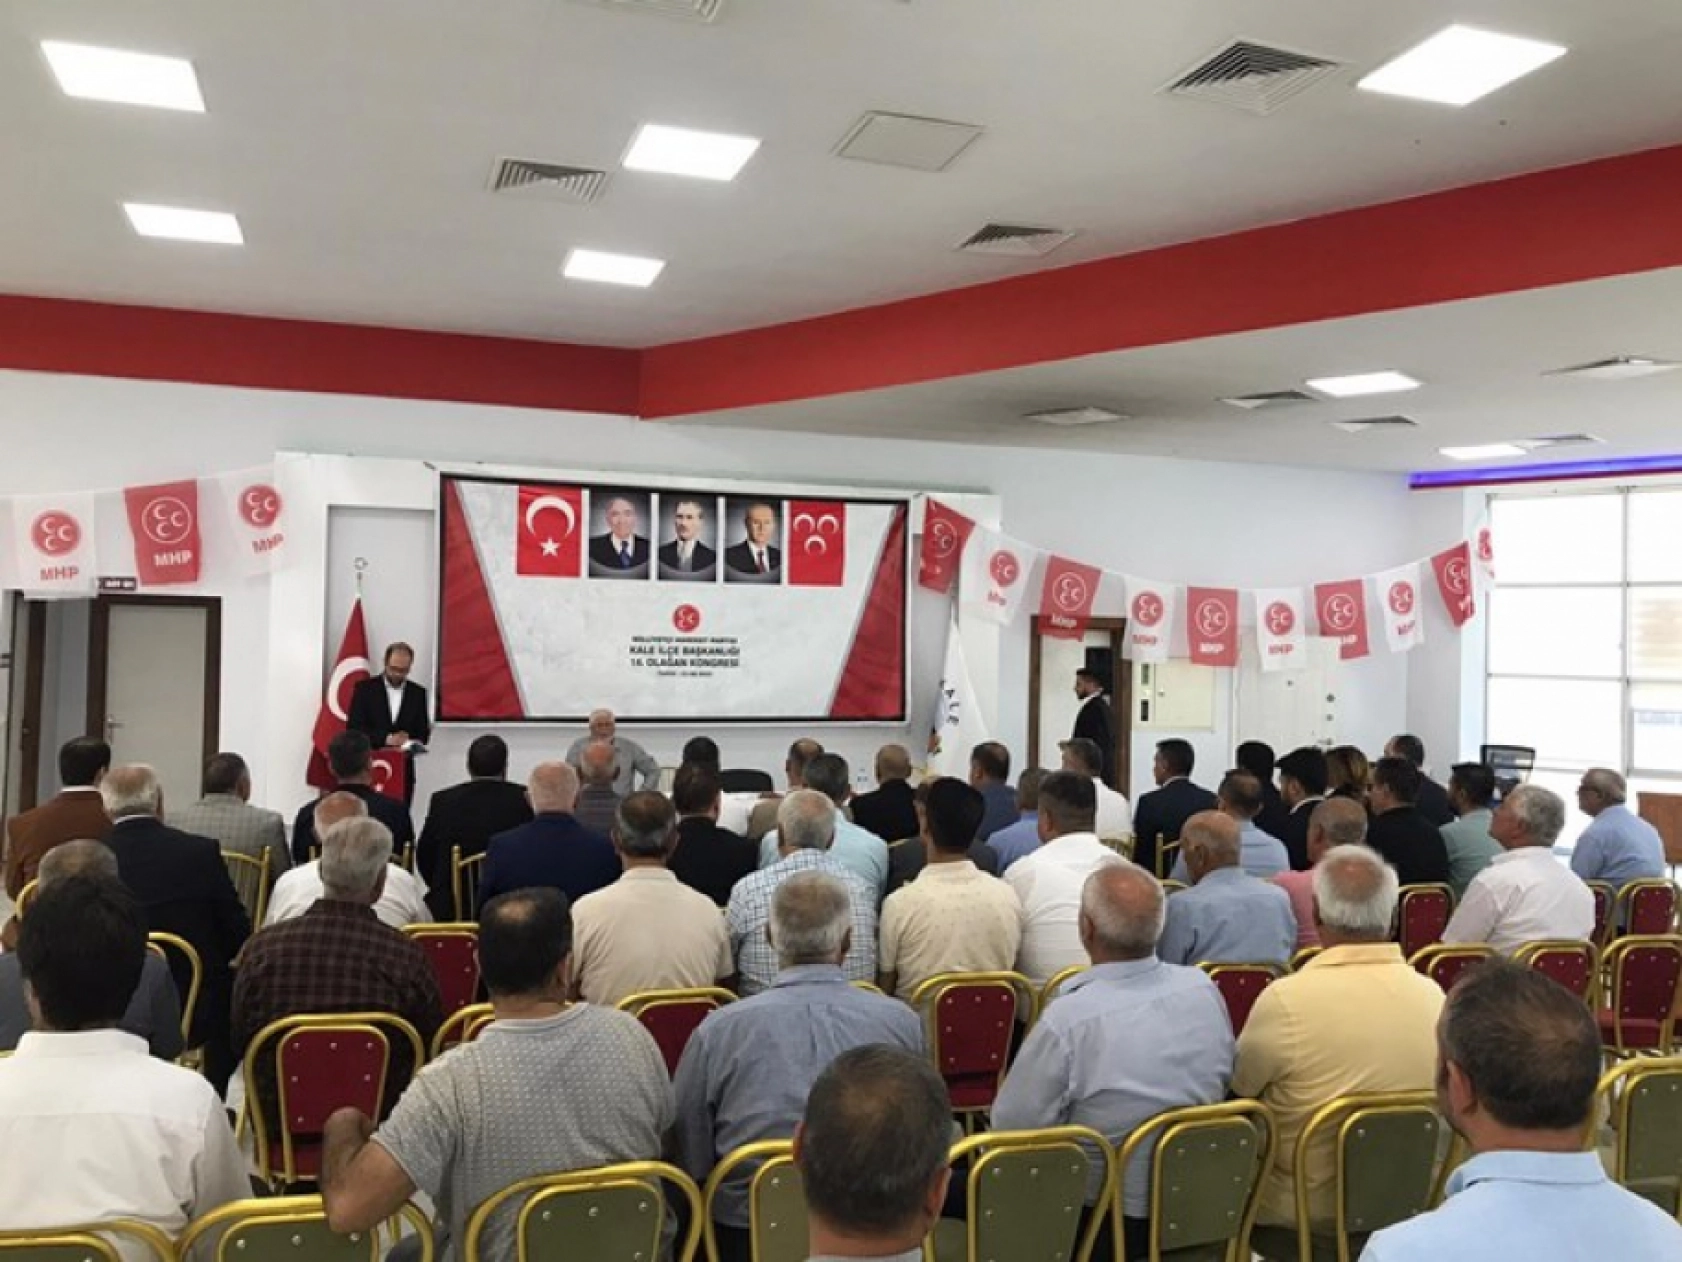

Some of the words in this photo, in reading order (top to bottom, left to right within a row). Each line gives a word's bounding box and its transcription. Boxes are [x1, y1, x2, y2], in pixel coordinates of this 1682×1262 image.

[253, 534, 284, 553] MHP
[153, 550, 192, 567] MHP
[39, 566, 80, 581] MHP
